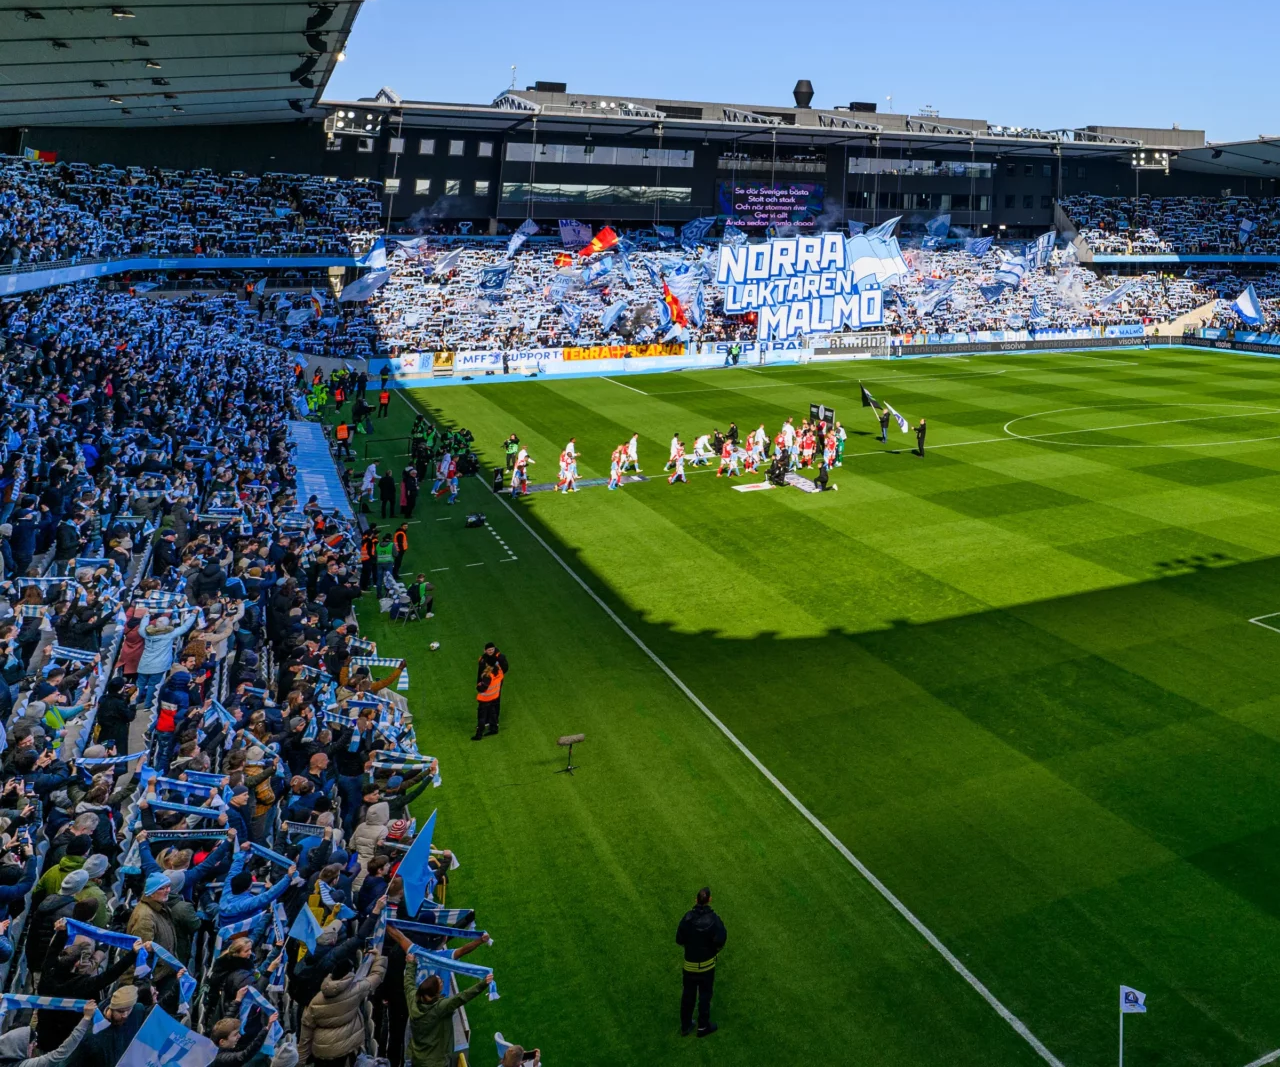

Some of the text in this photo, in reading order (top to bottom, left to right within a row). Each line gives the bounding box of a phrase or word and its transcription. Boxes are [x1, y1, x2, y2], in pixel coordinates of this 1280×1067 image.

[760, 187, 788, 196] Sveriges
[789, 188, 809, 196] bästa
[748, 195, 764, 203] Stolt
[754, 211, 768, 219] Ger
[717, 233, 845, 283] NORRA
[726, 270, 854, 310] LÄKTAREN
[758, 283, 883, 341] MALMÖ
[1118, 327, 1144, 335] MALMÖ
[1000, 341, 1026, 350] visolve
[1044, 339, 1073, 348] enklare
[1074, 337, 1113, 347] arbetsdag
[1118, 337, 1142, 345] visolve
[1215, 340, 1232, 349] visolve
[914, 344, 947, 354] enklare
[948, 342, 992, 353] arbetsdag
[563, 346, 609, 362] TERRA
[463, 354, 487, 365] MFF
